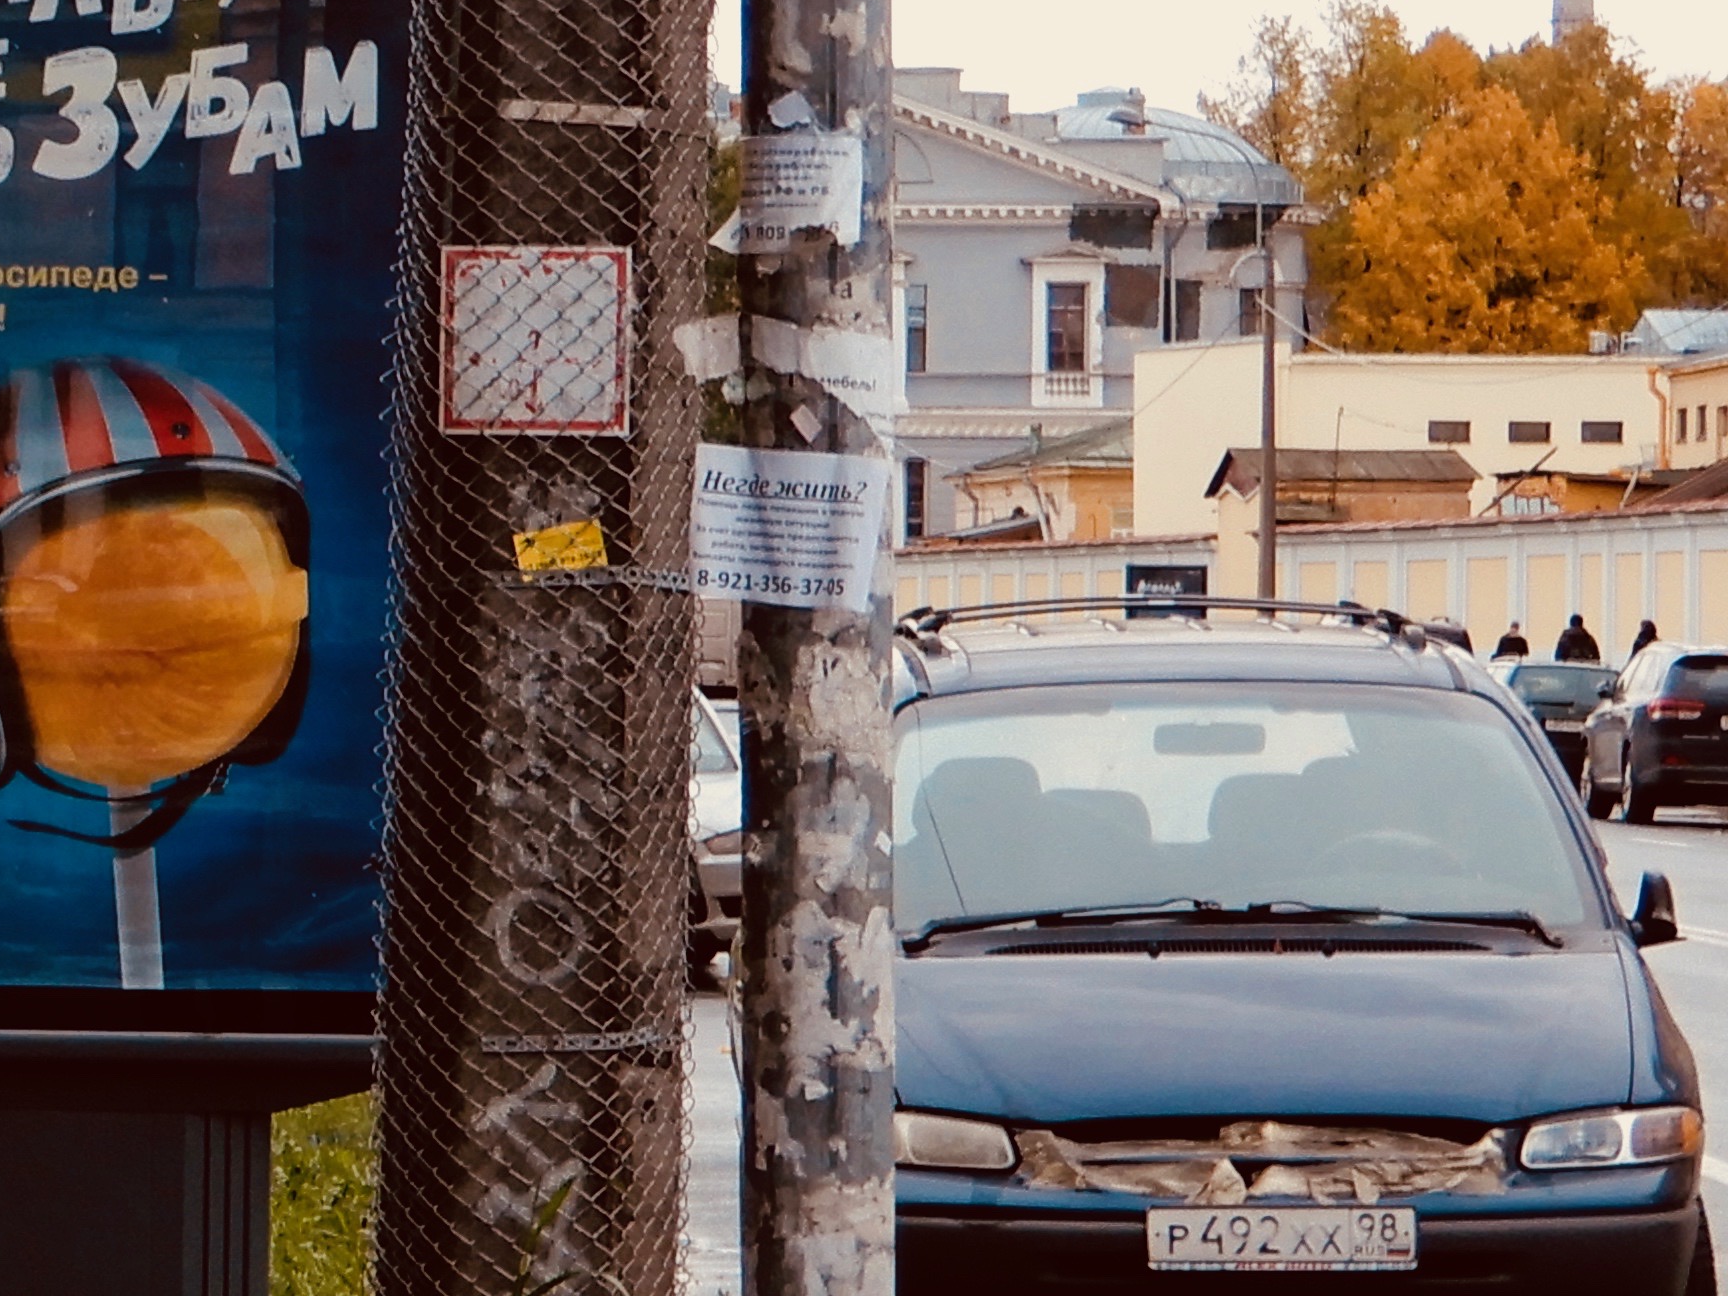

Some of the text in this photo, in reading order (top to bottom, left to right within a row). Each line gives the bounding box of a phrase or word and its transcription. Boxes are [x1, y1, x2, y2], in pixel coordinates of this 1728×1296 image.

[32, 40, 379, 181] ЗУБАМ
[702, 470, 868, 501] Негде жить?
[697, 570, 845, 596] 8-921-356-37-05
[1358, 1213, 1398, 1242] 98
